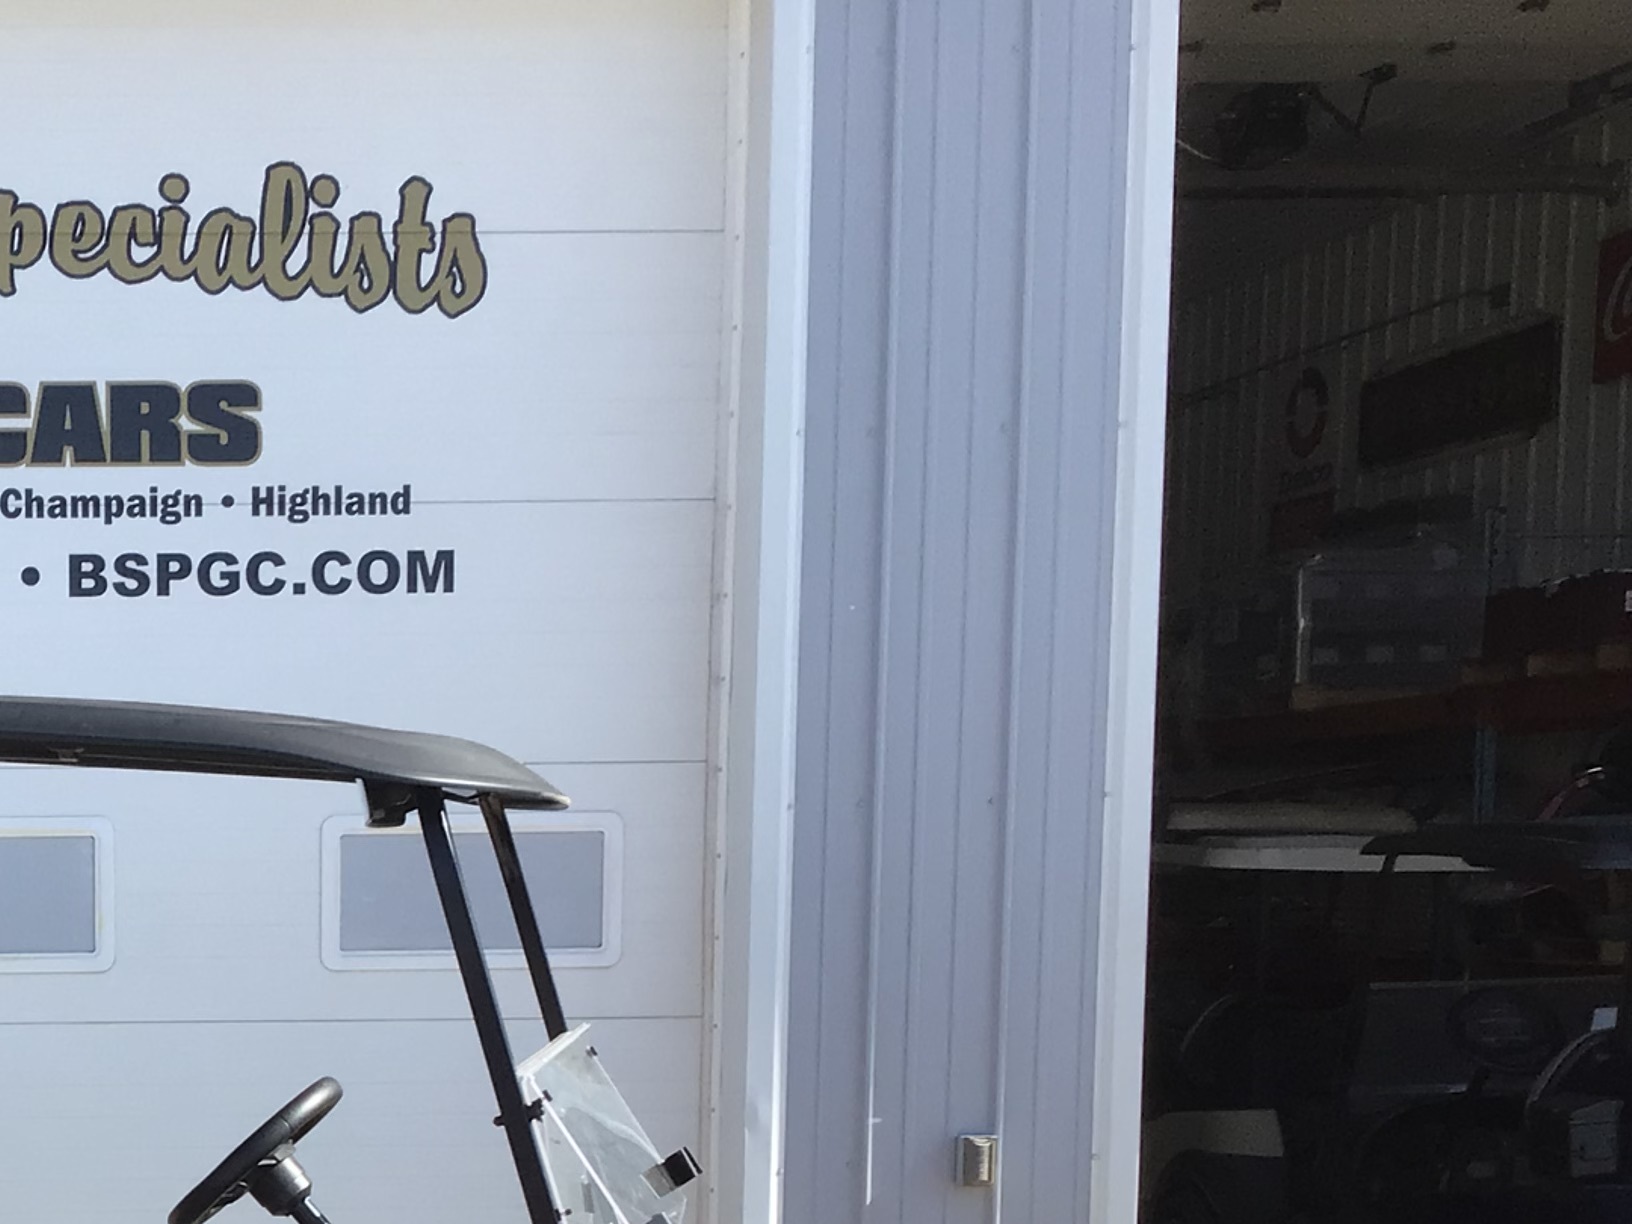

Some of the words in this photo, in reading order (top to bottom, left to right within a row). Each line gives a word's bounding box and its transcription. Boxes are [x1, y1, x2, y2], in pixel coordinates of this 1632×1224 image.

[0, 486, 204, 525] Champaign
[251, 484, 412, 523] Highland
[68, 549, 456, 598] BSPGC.COM
